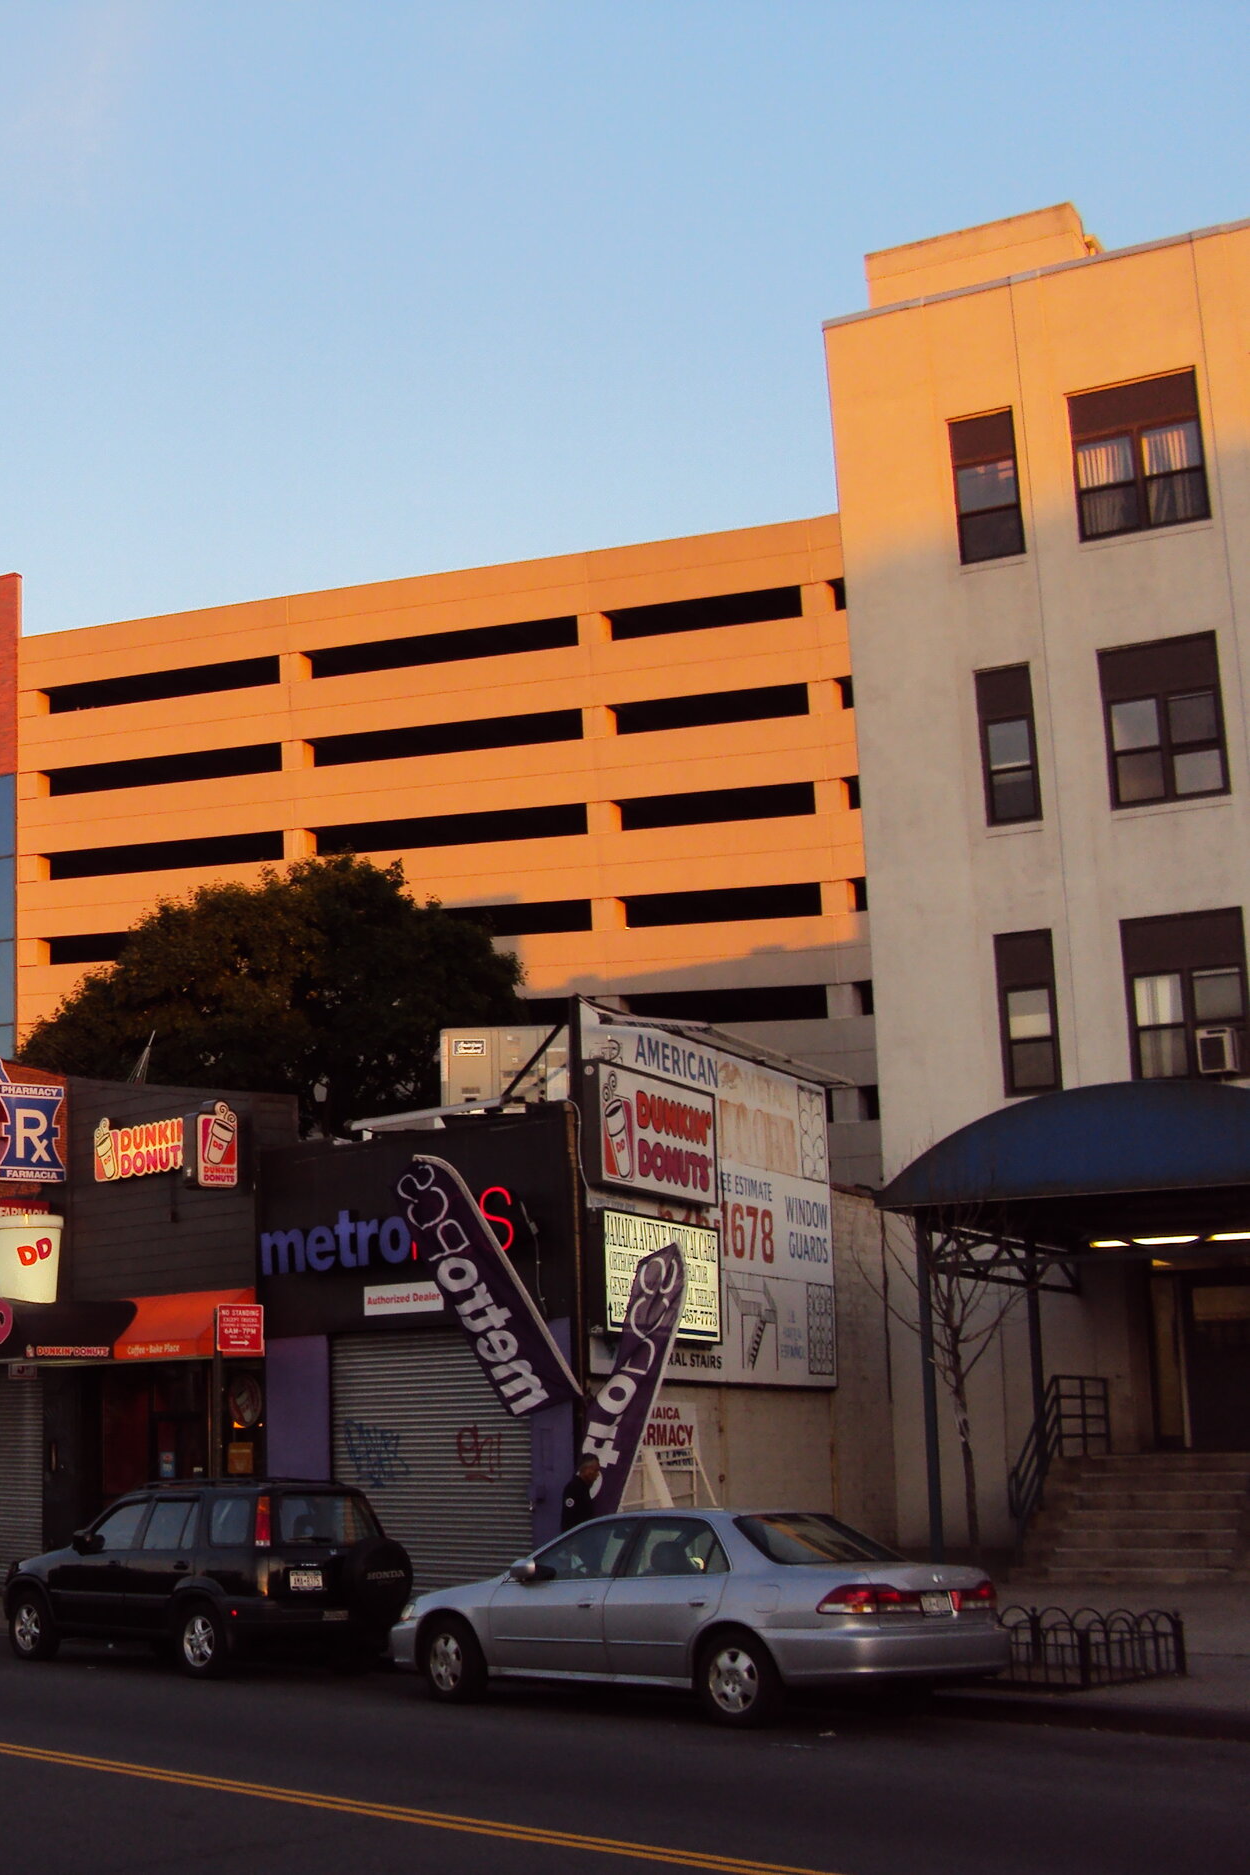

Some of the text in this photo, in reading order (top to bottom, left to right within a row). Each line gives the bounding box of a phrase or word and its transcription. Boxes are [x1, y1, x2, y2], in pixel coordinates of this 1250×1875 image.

[635, 1034, 718, 1088] AMERICAN
[1, 1085, 58, 1097] PHARMACY
[120, 1144, 183, 1176] DONUT
[637, 1138, 711, 1193] DONUTS
[6, 1169, 58, 1180] FARMACIA
[203, 1174, 235, 1183] DONUTS
[735, 1175, 772, 1201] ESTIMATE
[785, 1196, 828, 1230] WINDOW
[606, 1214, 638, 1249] JAMAICA
[789, 1231, 829, 1264] GUARDS
[367, 1290, 442, 1306] Authorized Dealer
[74, 1346, 109, 1357] DONUTS
[127, 1343, 180, 1355] Coffee Bake Place
[690, 1353, 722, 1370] STAIRS
[366, 1569, 406, 1581] HONDA
